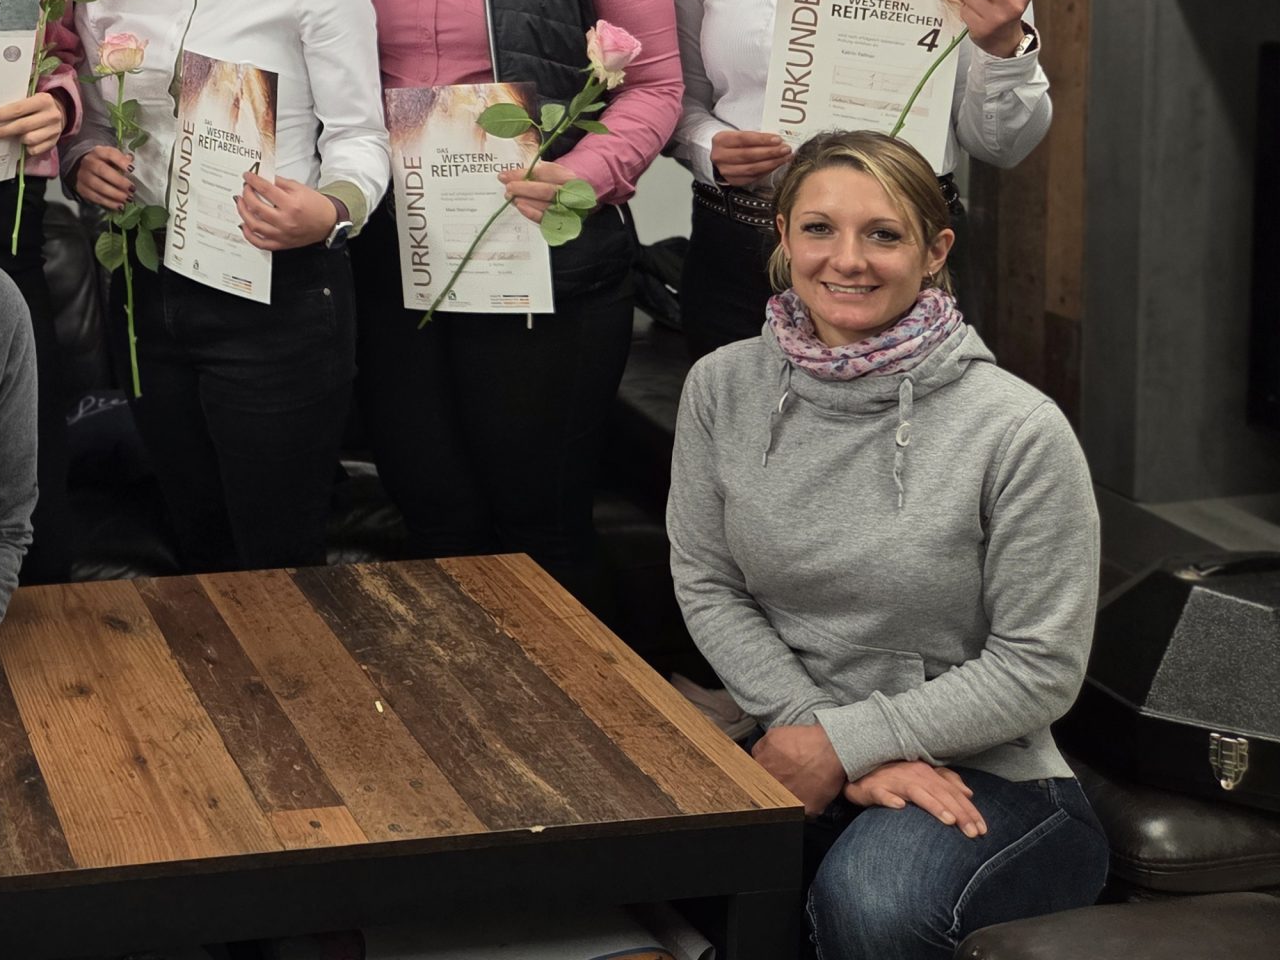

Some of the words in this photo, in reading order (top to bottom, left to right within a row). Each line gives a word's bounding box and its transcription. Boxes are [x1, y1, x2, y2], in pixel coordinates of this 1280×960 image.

[831, 3, 944, 28] REITABZEICHEN
[916, 28, 941, 53] 4
[198, 134, 262, 160] REITABZEICHEN
[206, 126, 244, 144] WESTERN-
[431, 162, 525, 177] REITABZEICHEN
[442, 152, 498, 163] WESTERN-
[172, 119, 195, 250] URKUNDE
[403, 156, 432, 287] URKUNDE
